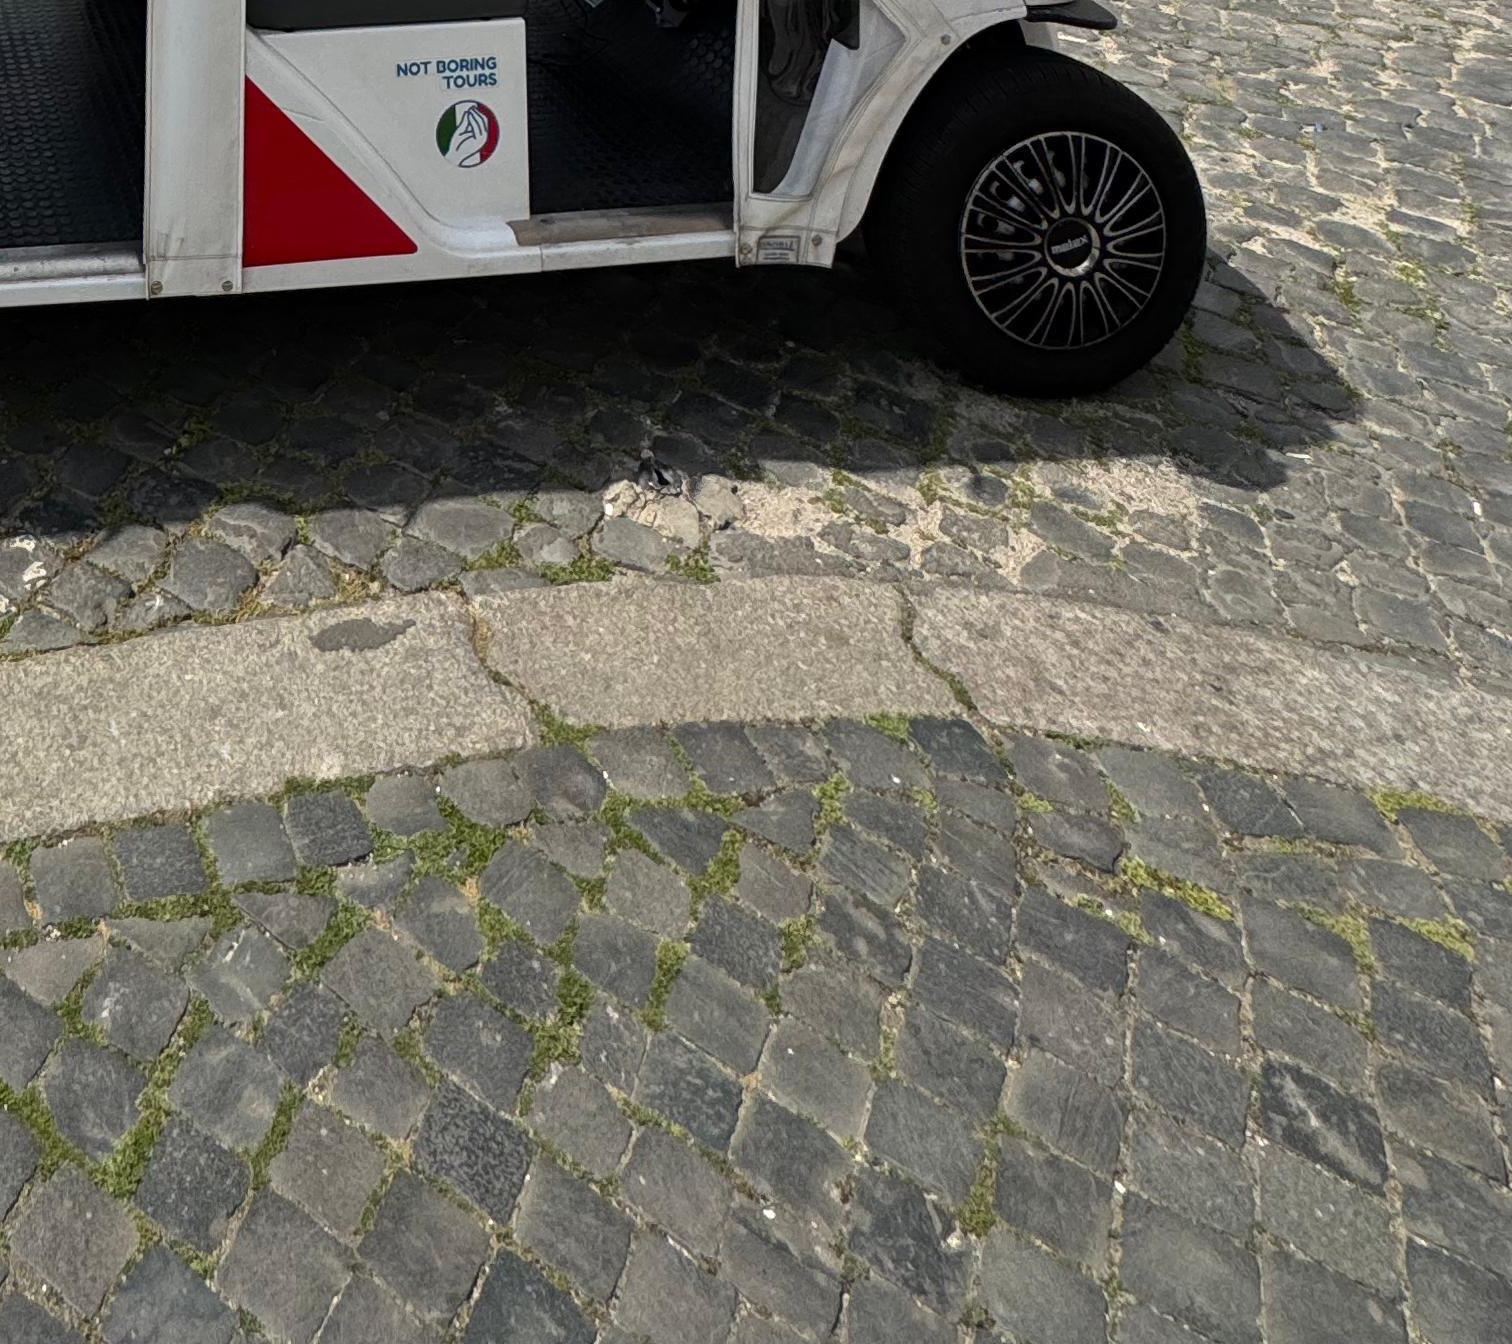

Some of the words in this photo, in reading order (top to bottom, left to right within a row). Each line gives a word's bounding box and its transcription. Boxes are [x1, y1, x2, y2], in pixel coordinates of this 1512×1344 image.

[396, 61, 432, 77] NOT
[436, 56, 497, 74] BORING
[442, 73, 498, 89] TOURS
